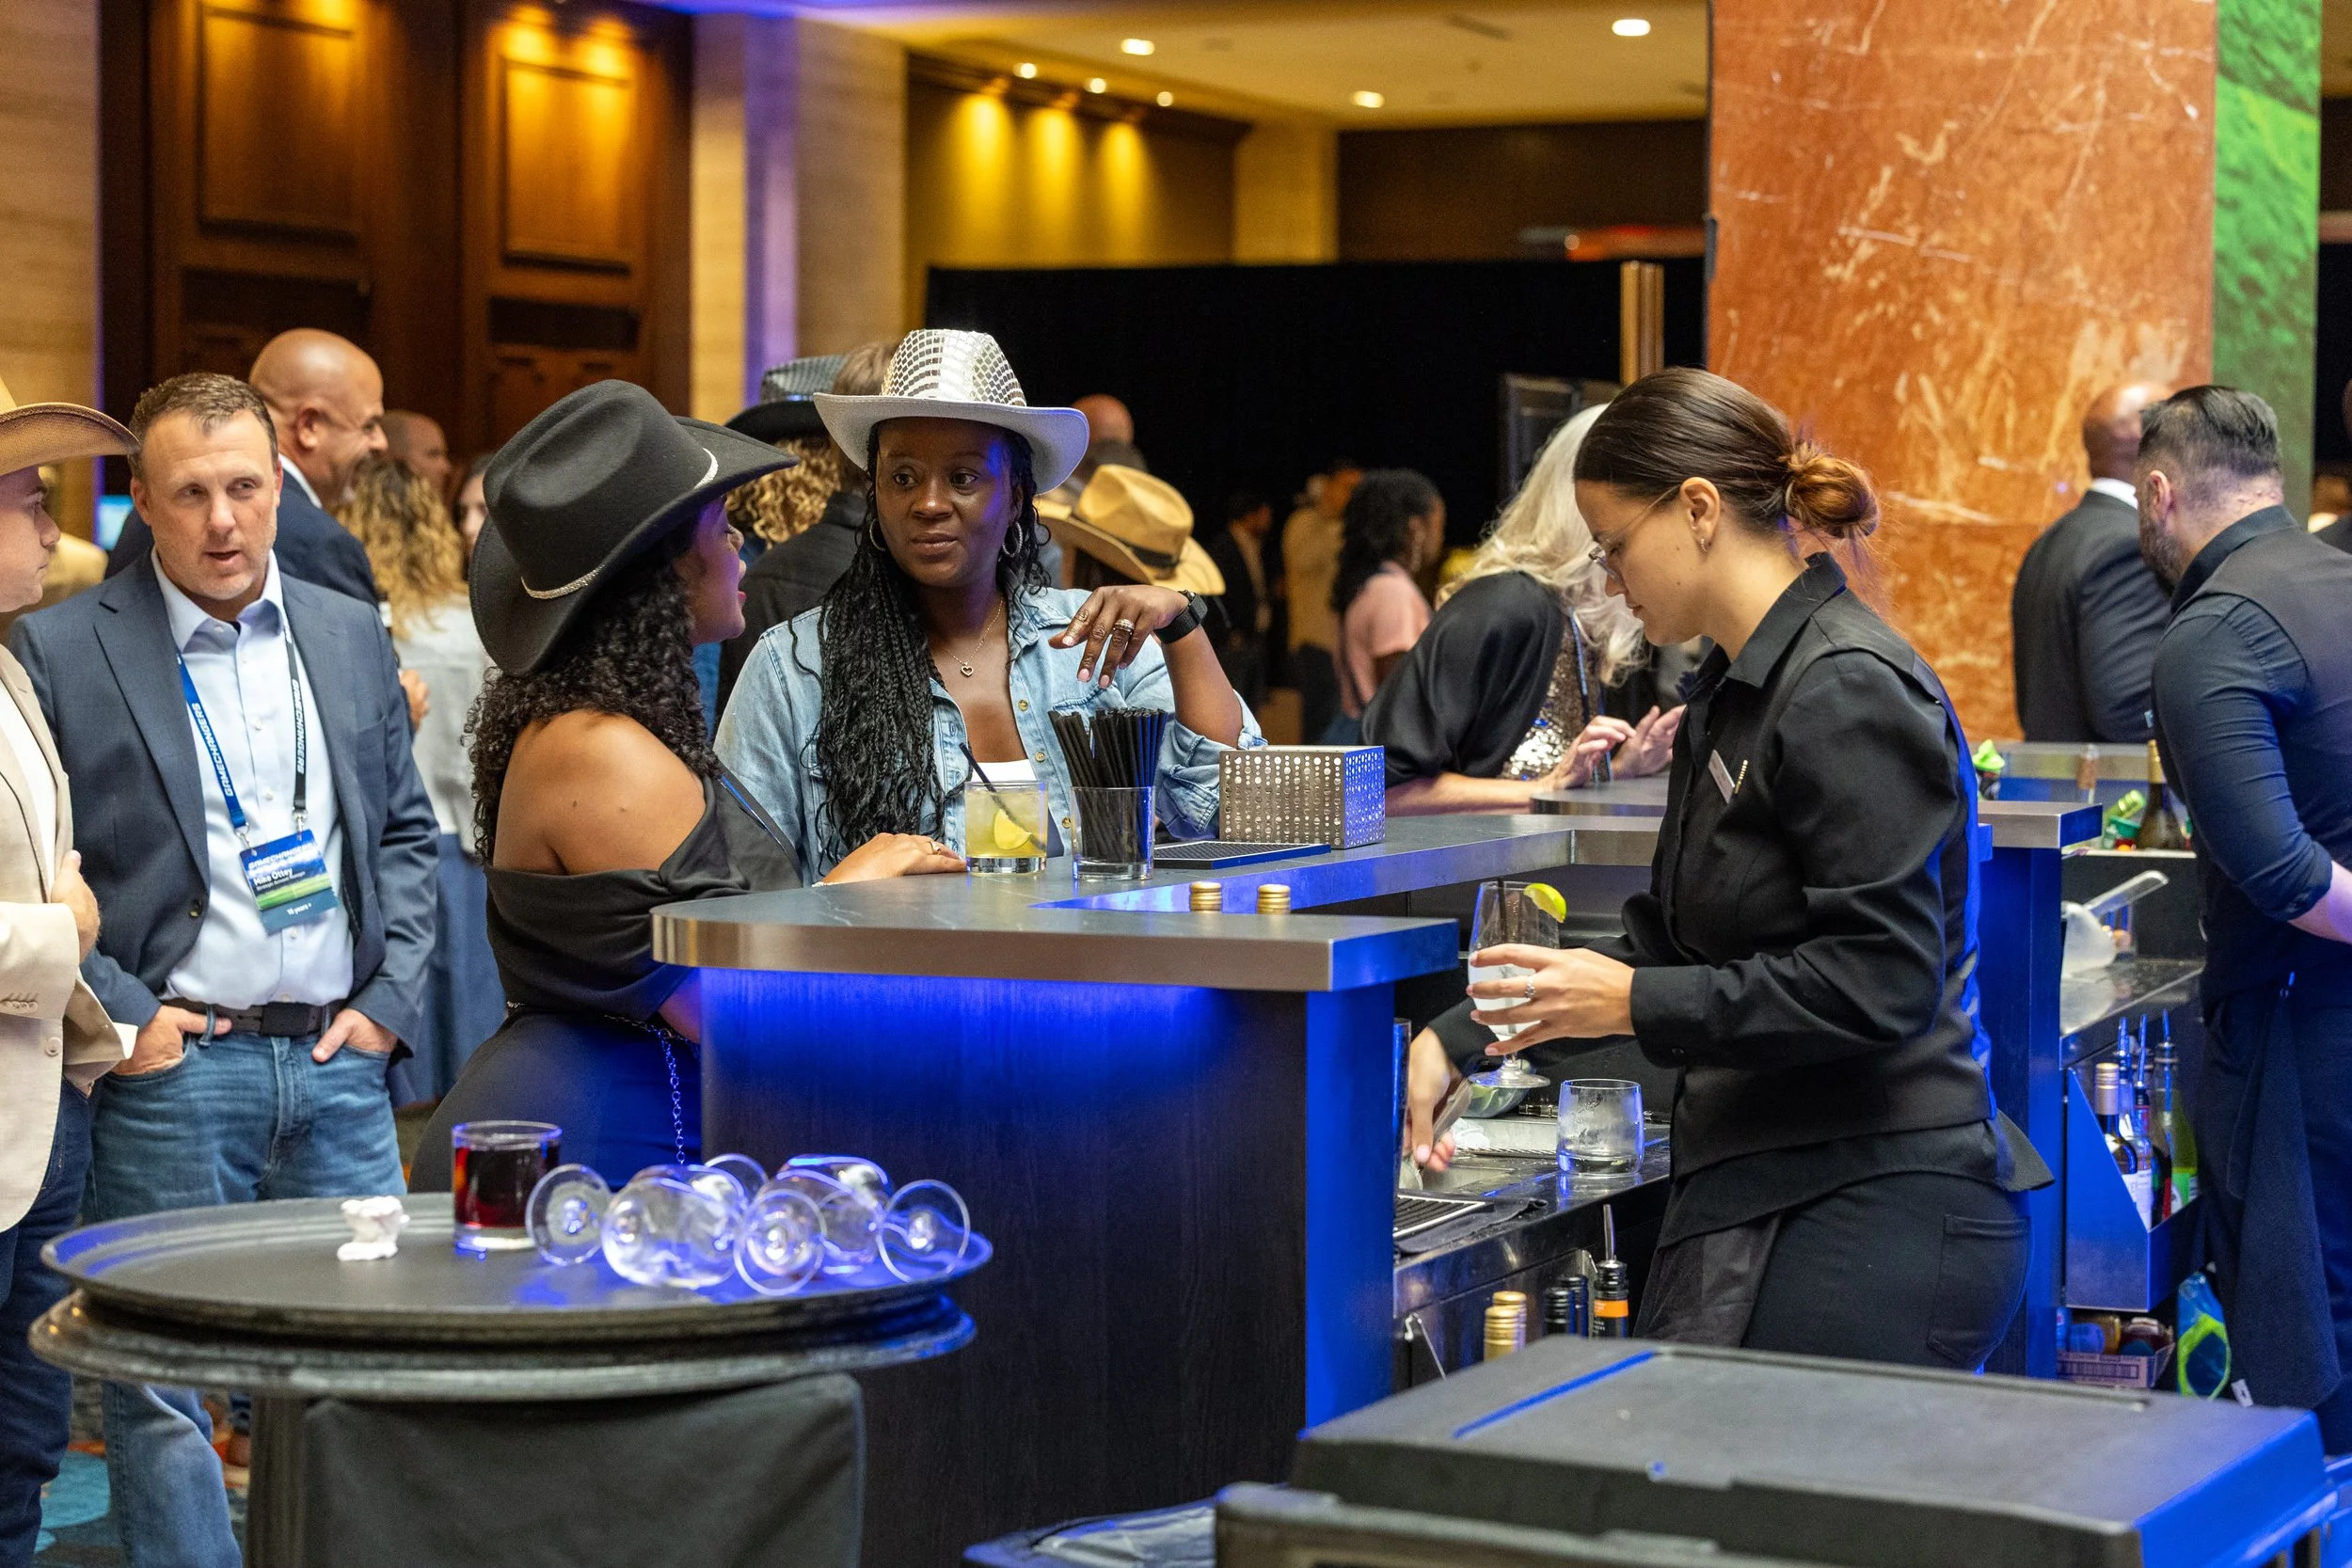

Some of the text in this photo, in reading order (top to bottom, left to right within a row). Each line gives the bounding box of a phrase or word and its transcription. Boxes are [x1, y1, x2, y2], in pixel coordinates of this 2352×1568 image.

[191, 702, 234, 798] GAMECHANGERS
[292, 678, 305, 774] GAMECHANGERS
[253, 867, 294, 885] Mike Ottey
